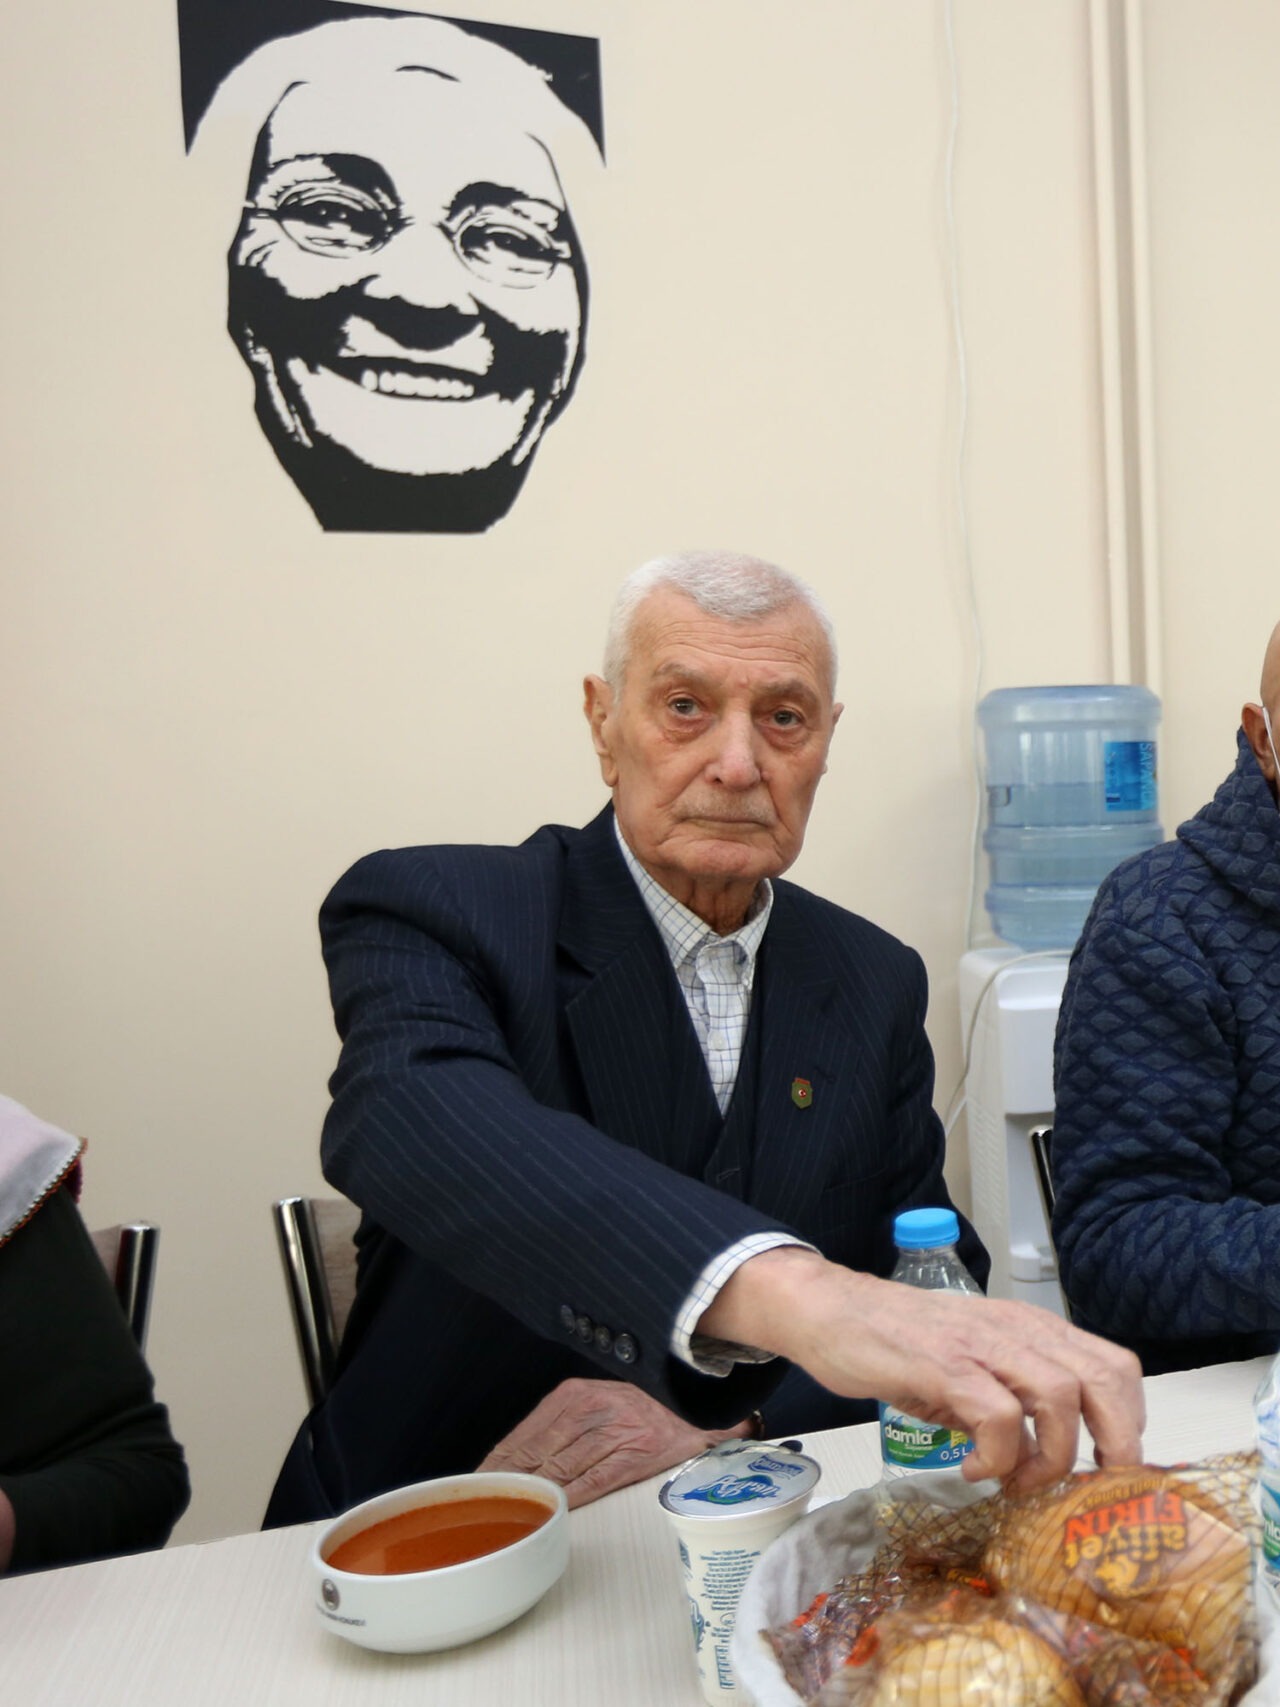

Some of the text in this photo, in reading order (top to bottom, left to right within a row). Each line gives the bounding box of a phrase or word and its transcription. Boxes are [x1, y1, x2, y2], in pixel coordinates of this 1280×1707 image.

[884, 1424, 933, 1445] damla
[1064, 1492, 1187, 1545] FIRIN
[1065, 1520, 1187, 1569] afiyet
